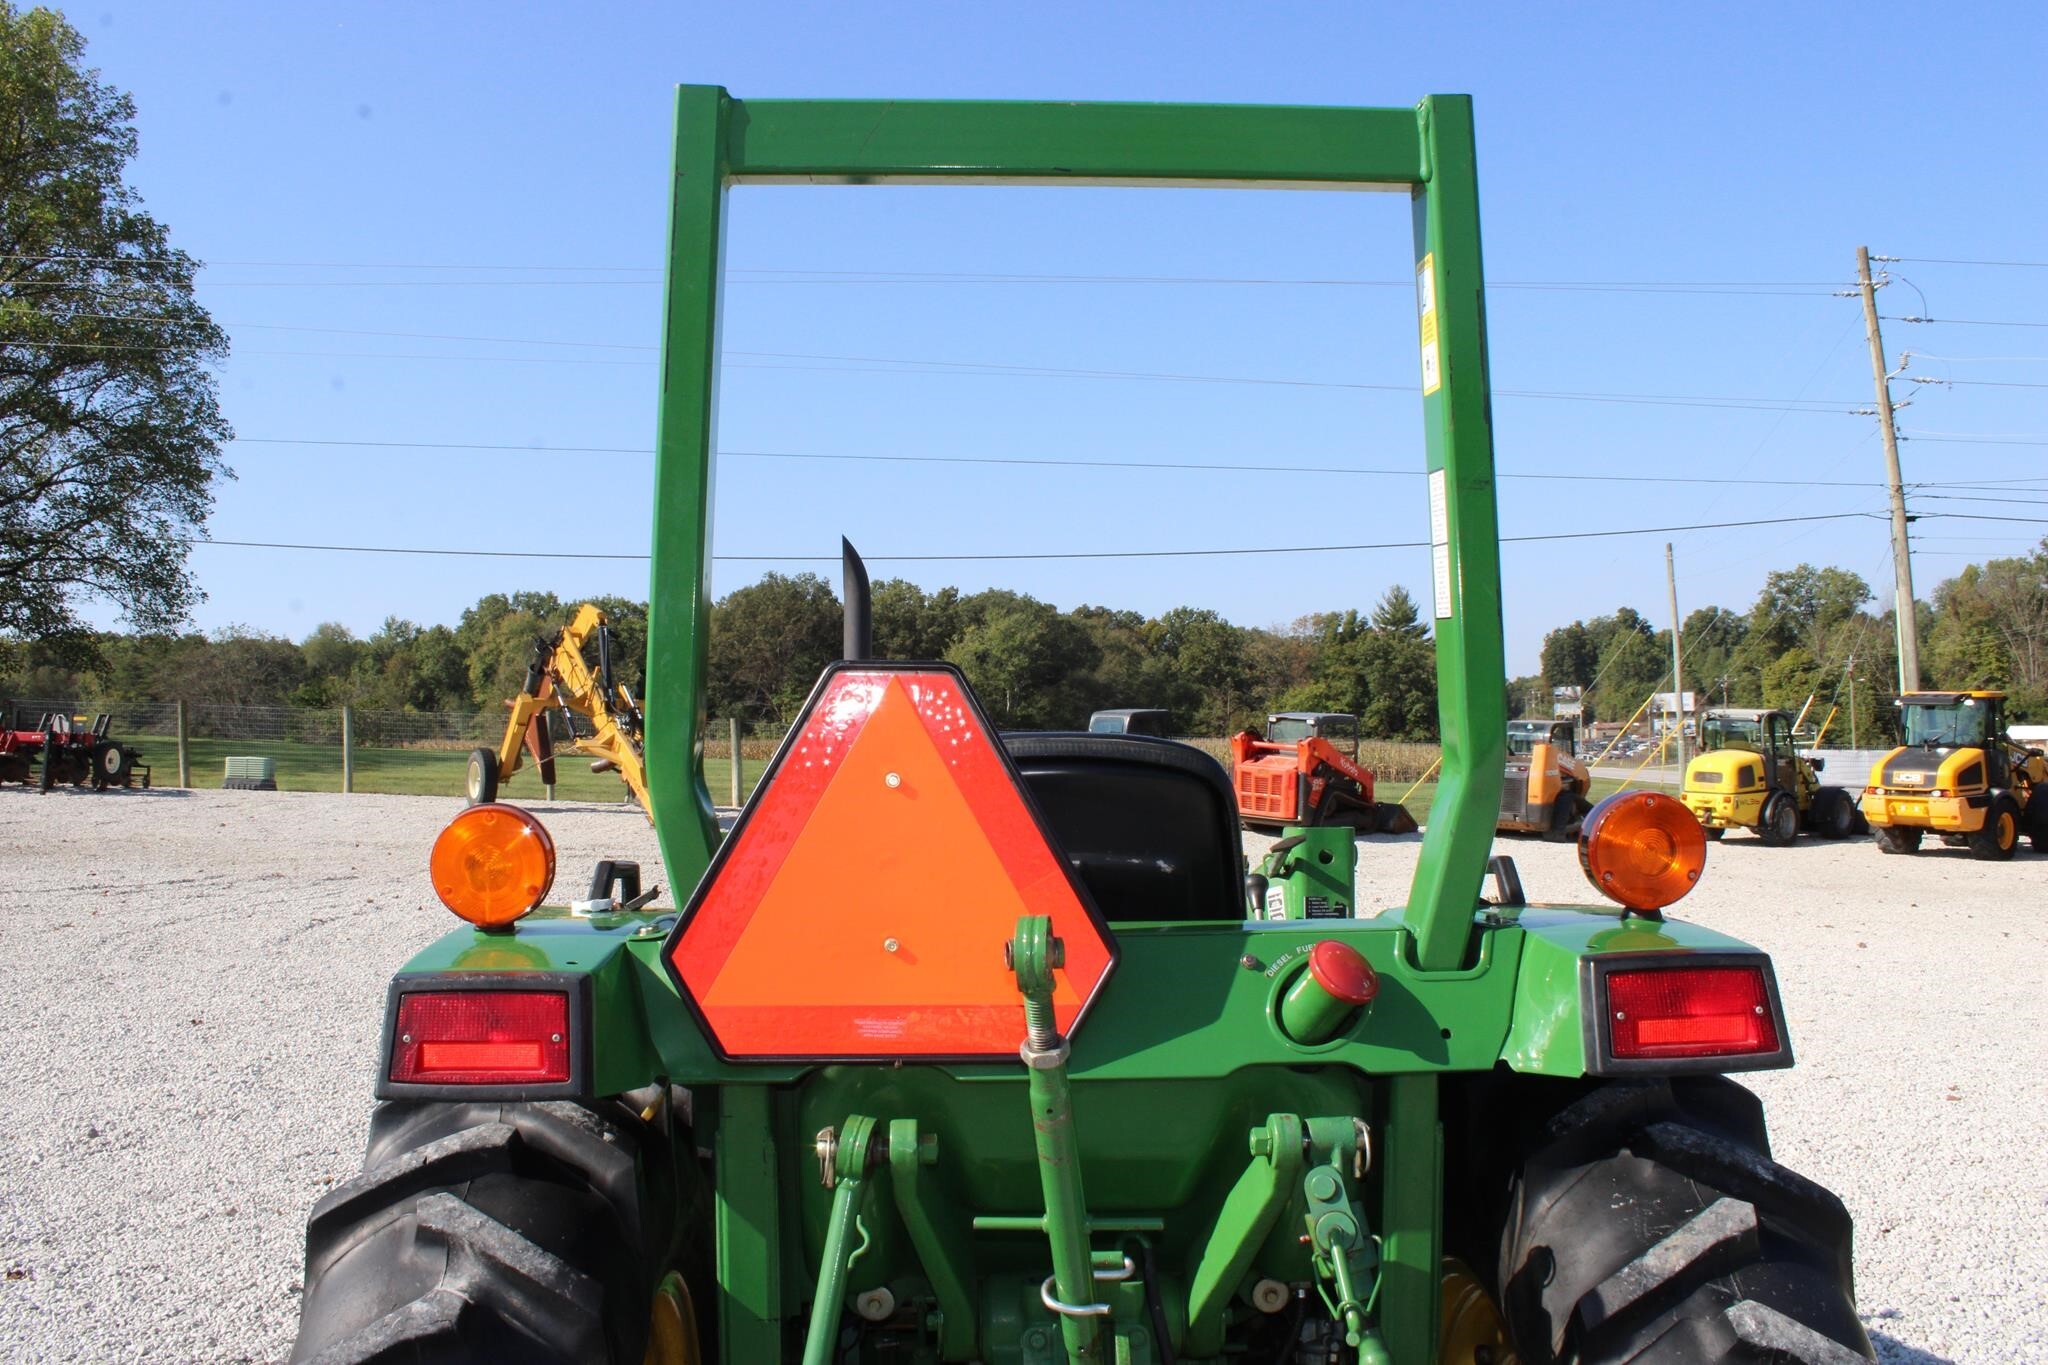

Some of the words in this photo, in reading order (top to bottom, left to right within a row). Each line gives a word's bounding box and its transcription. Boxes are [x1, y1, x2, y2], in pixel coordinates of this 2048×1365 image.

[1895, 773, 1921, 782] JCB
[1267, 953, 1293, 977] DIESEL
[1296, 943, 1317, 954] FUE
